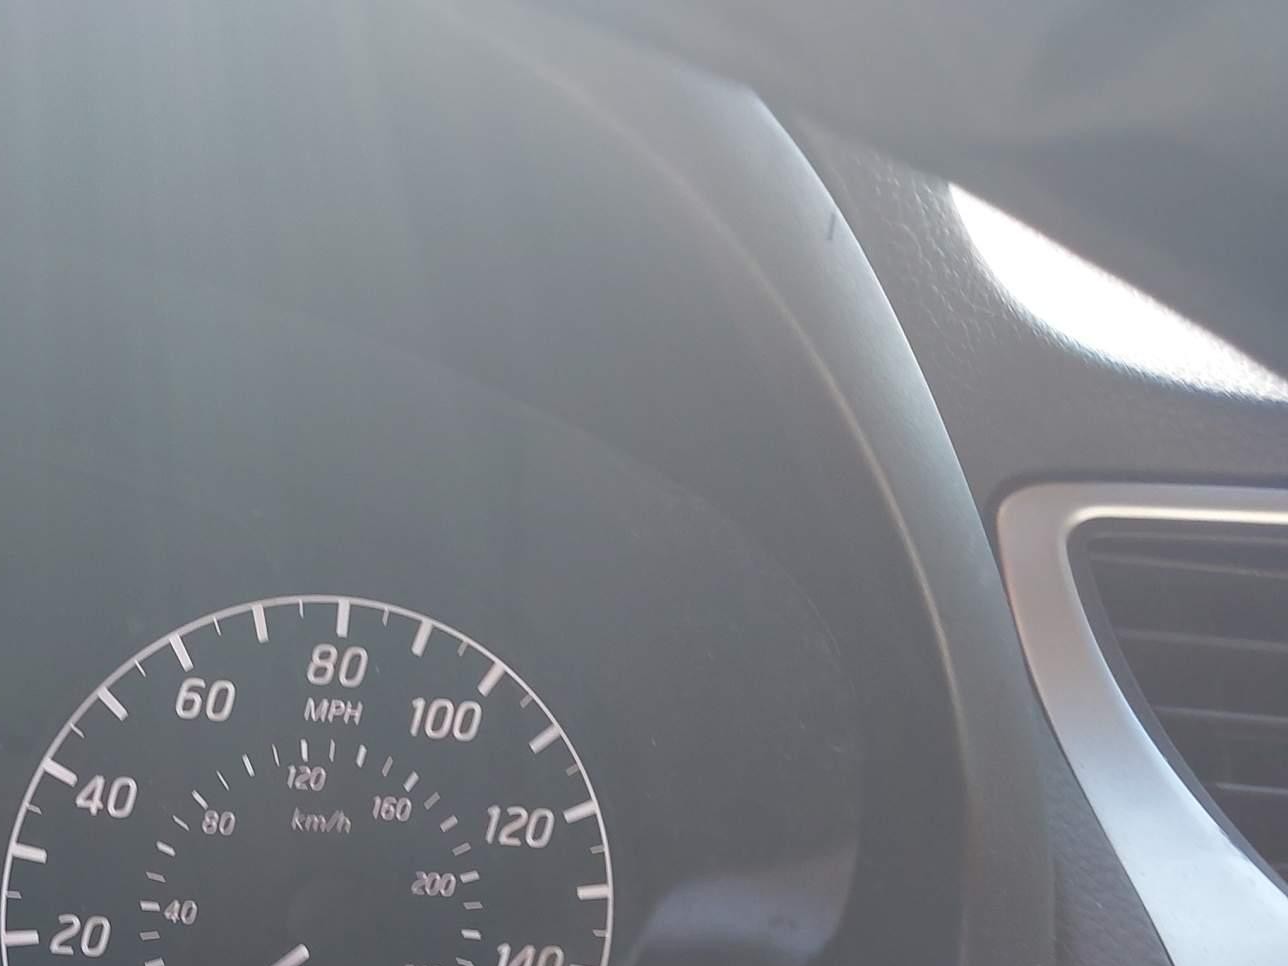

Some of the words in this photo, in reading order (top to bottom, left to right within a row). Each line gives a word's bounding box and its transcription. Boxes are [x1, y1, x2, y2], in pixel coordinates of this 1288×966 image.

[307, 645, 368, 686] 80
[176, 678, 235, 720] 60
[305, 698, 362, 724] MPH
[411, 698, 481, 740] 100
[288, 766, 326, 790] 120
[75, 776, 137, 817] 40
[373, 797, 411, 821] 160
[203, 811, 235, 834] 80
[292, 808, 351, 833] km/h
[486, 806, 554, 847] 120
[412, 872, 456, 896] 200
[165, 900, 197, 924] 40
[50, 915, 110, 956] 20
